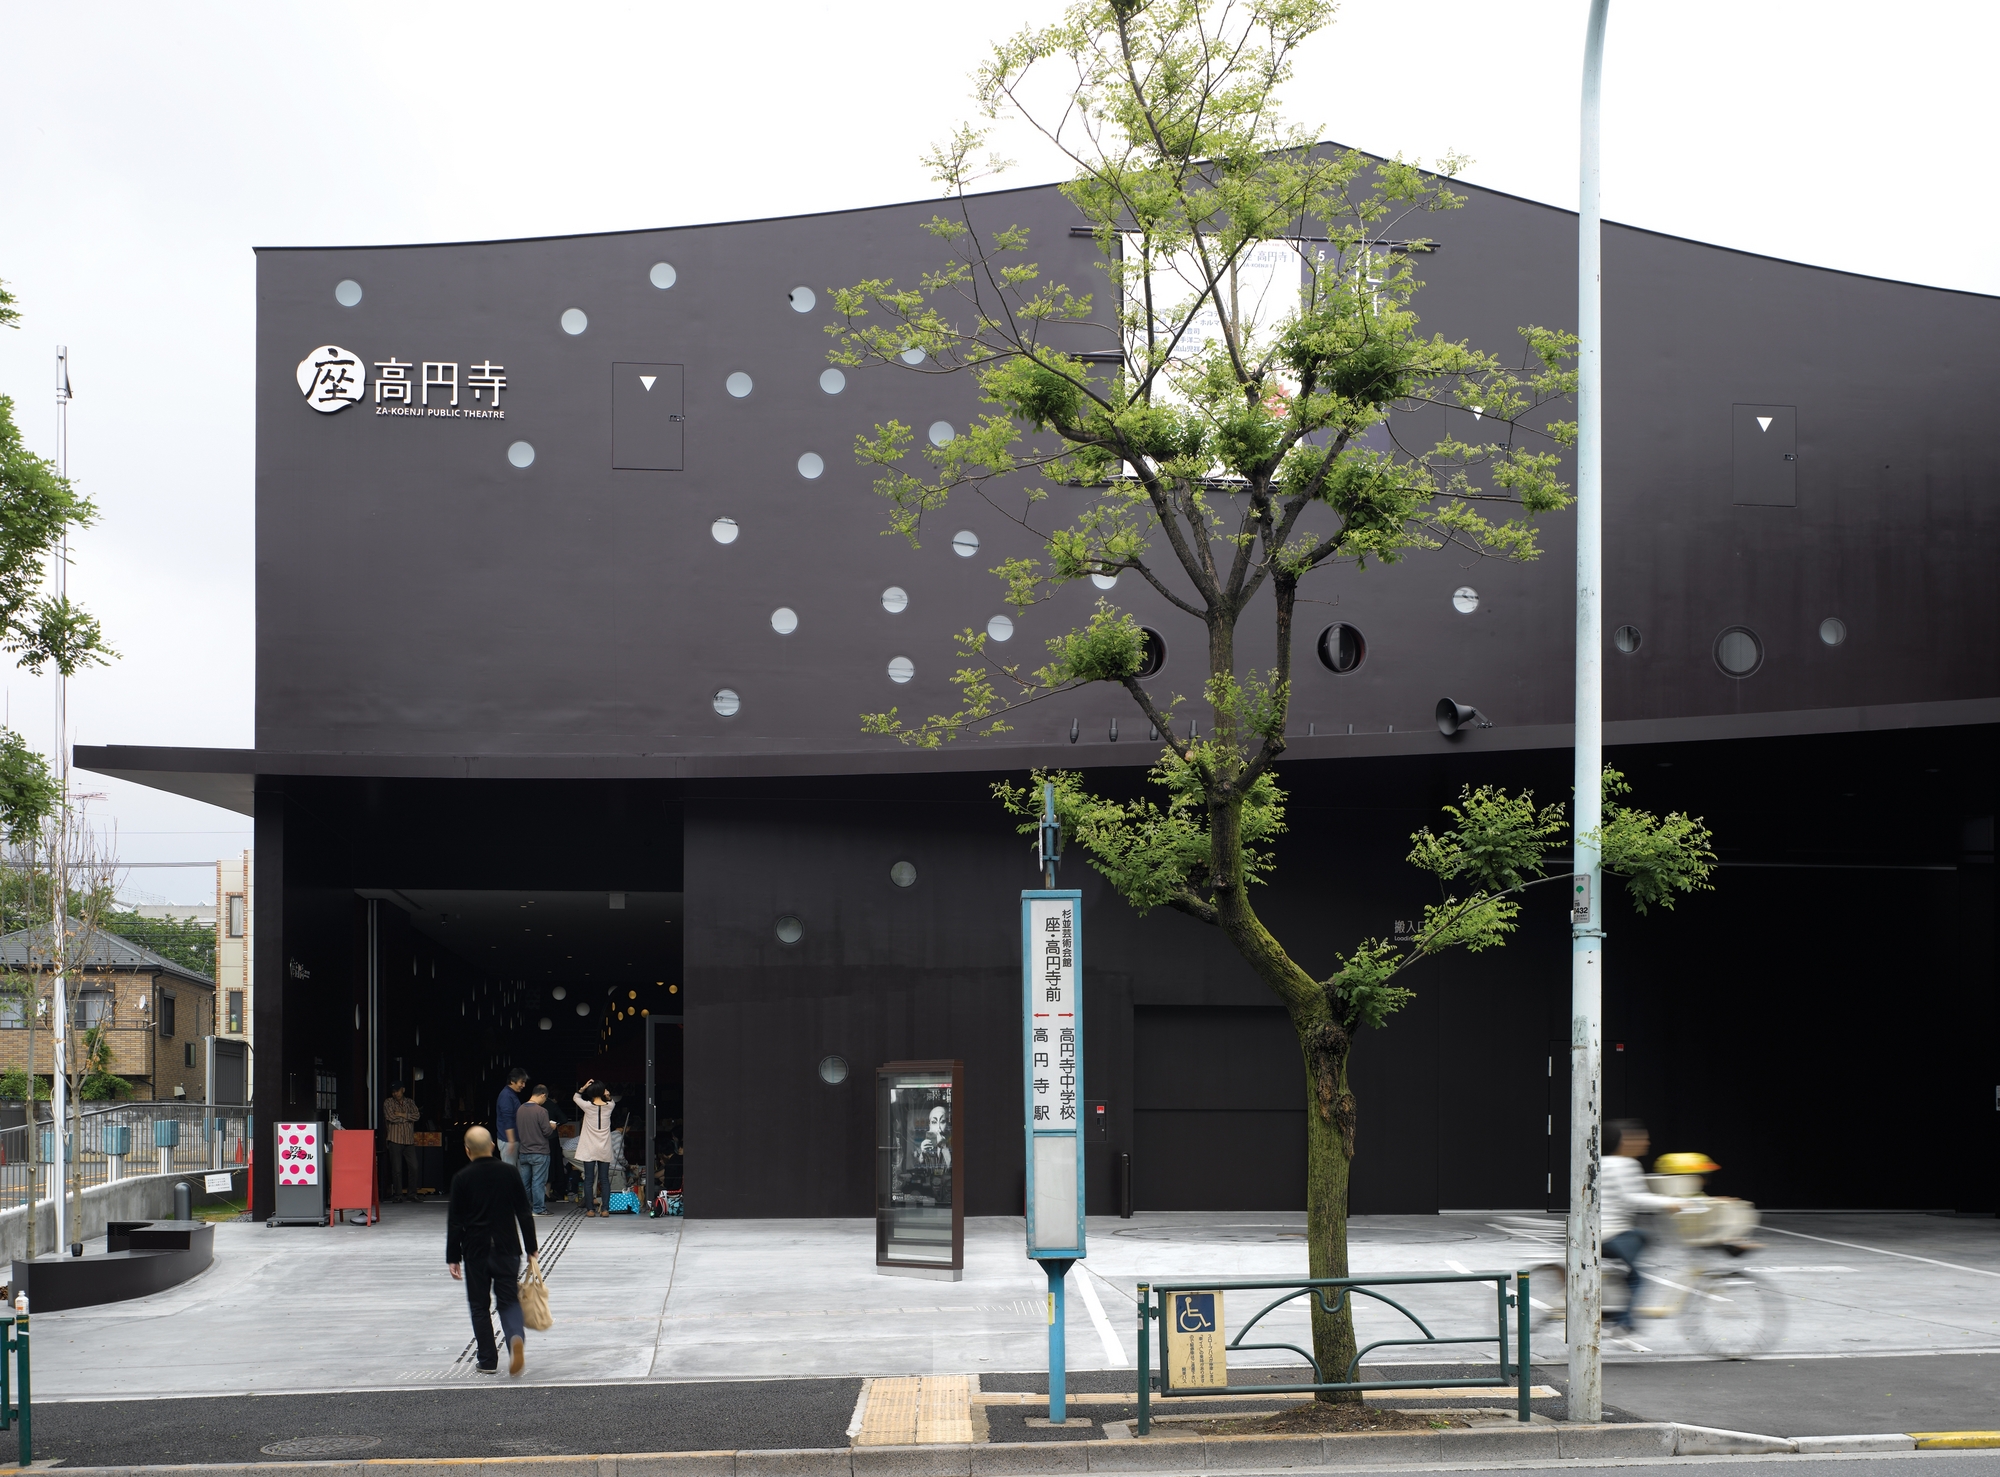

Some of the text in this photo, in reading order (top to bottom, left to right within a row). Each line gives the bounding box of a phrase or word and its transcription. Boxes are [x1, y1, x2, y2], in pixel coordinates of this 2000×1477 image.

[304, 347, 507, 407] 座 高円寺
[375, 406, 505, 419] ZA-KOENJI PUBLIC THEATRE
[1045, 917, 1061, 1002] 座・高円寺前
[1062, 909, 1072, 967] 杉並芸術会館
[1033, 1027, 1050, 1121] 高円寺駅
[1059, 1027, 1076, 1120] 高円寺中学校
